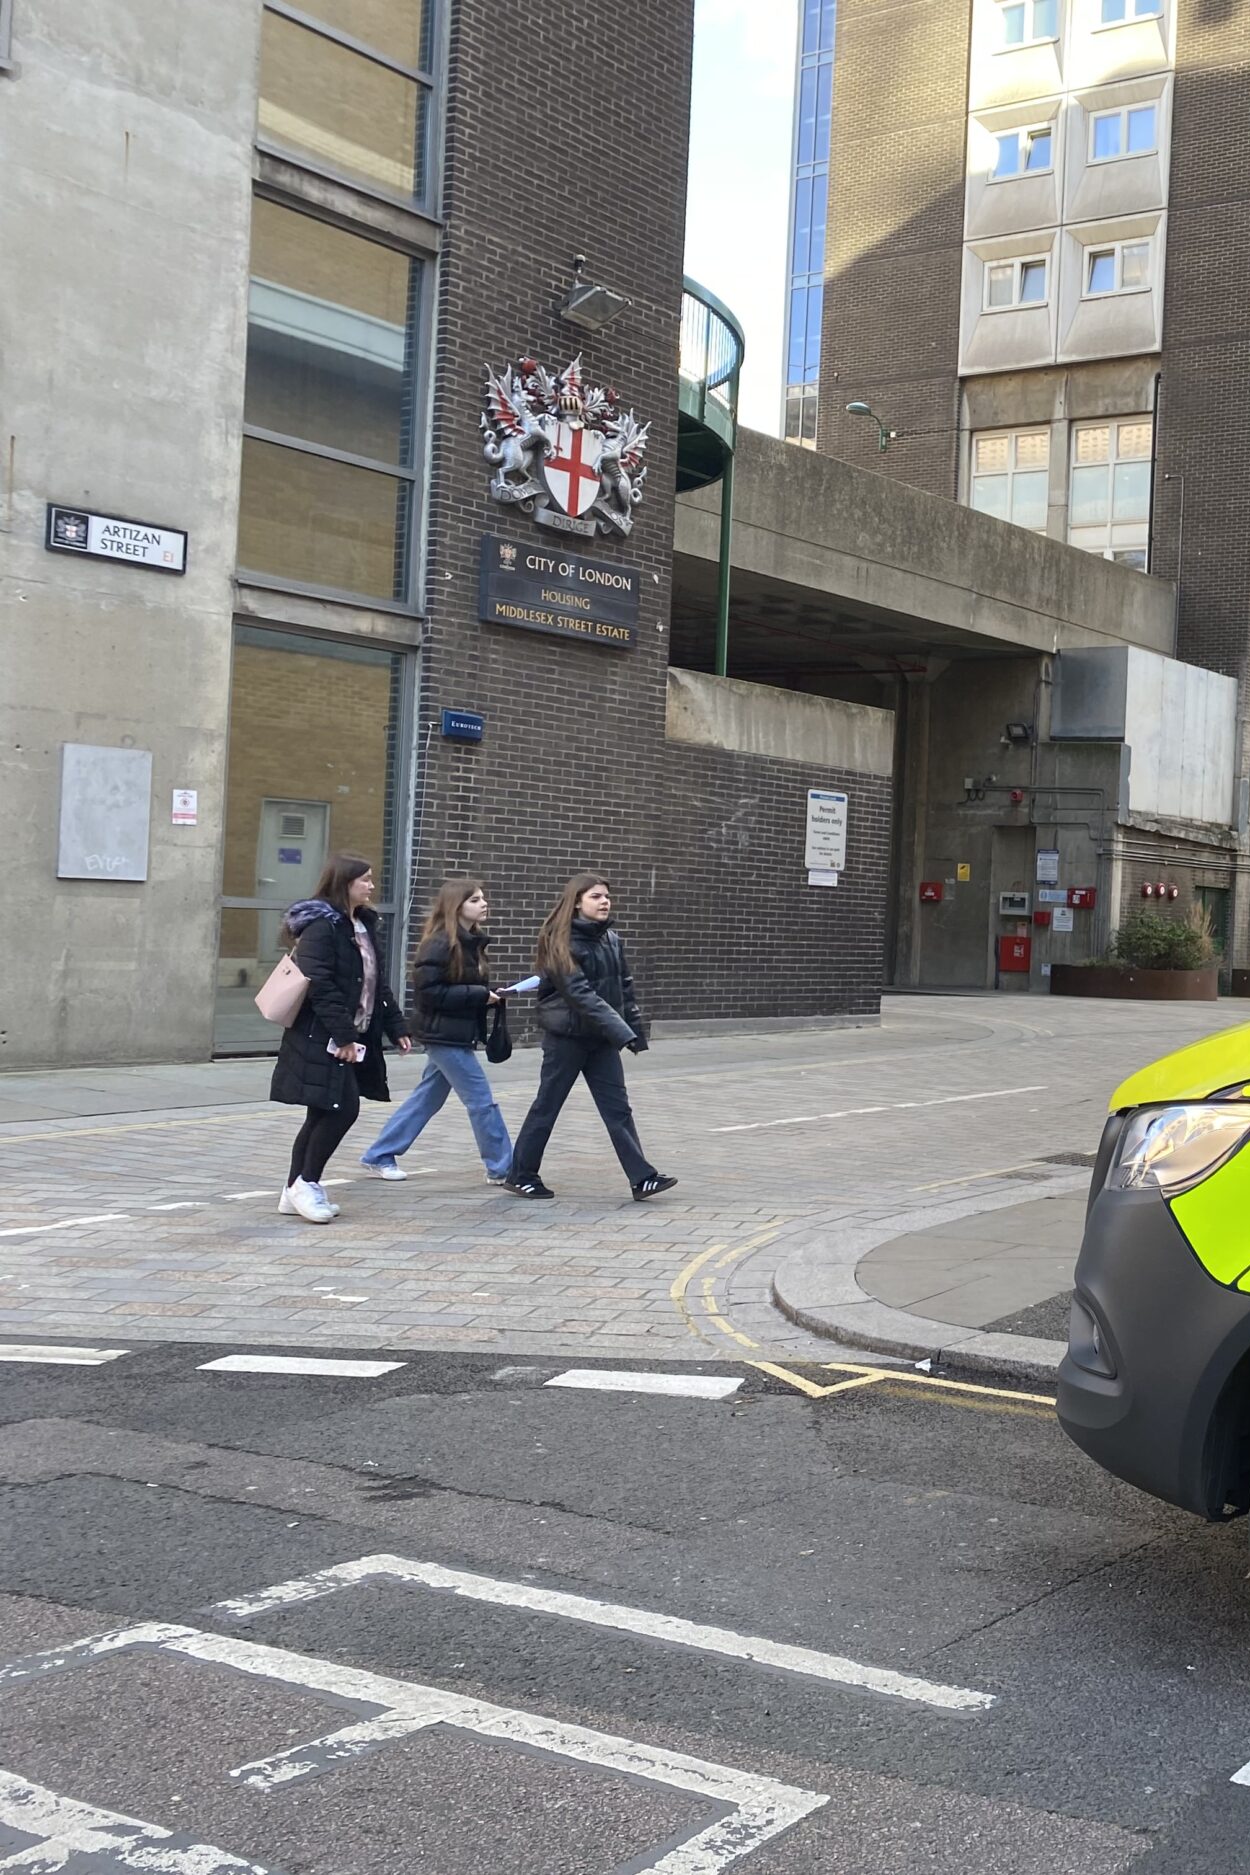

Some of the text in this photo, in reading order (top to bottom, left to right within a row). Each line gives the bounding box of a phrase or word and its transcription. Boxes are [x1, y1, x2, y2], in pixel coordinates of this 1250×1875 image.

[552, 515, 589, 534] DIRIGE
[102, 525, 161, 546] ARTIZAN
[100, 538, 148, 557] STREET
[526, 555, 631, 591] CITY OF LONDON
[541, 589, 590, 610] HOUSING
[495, 603, 630, 641] MIDDLESEX STREET ESTATE
